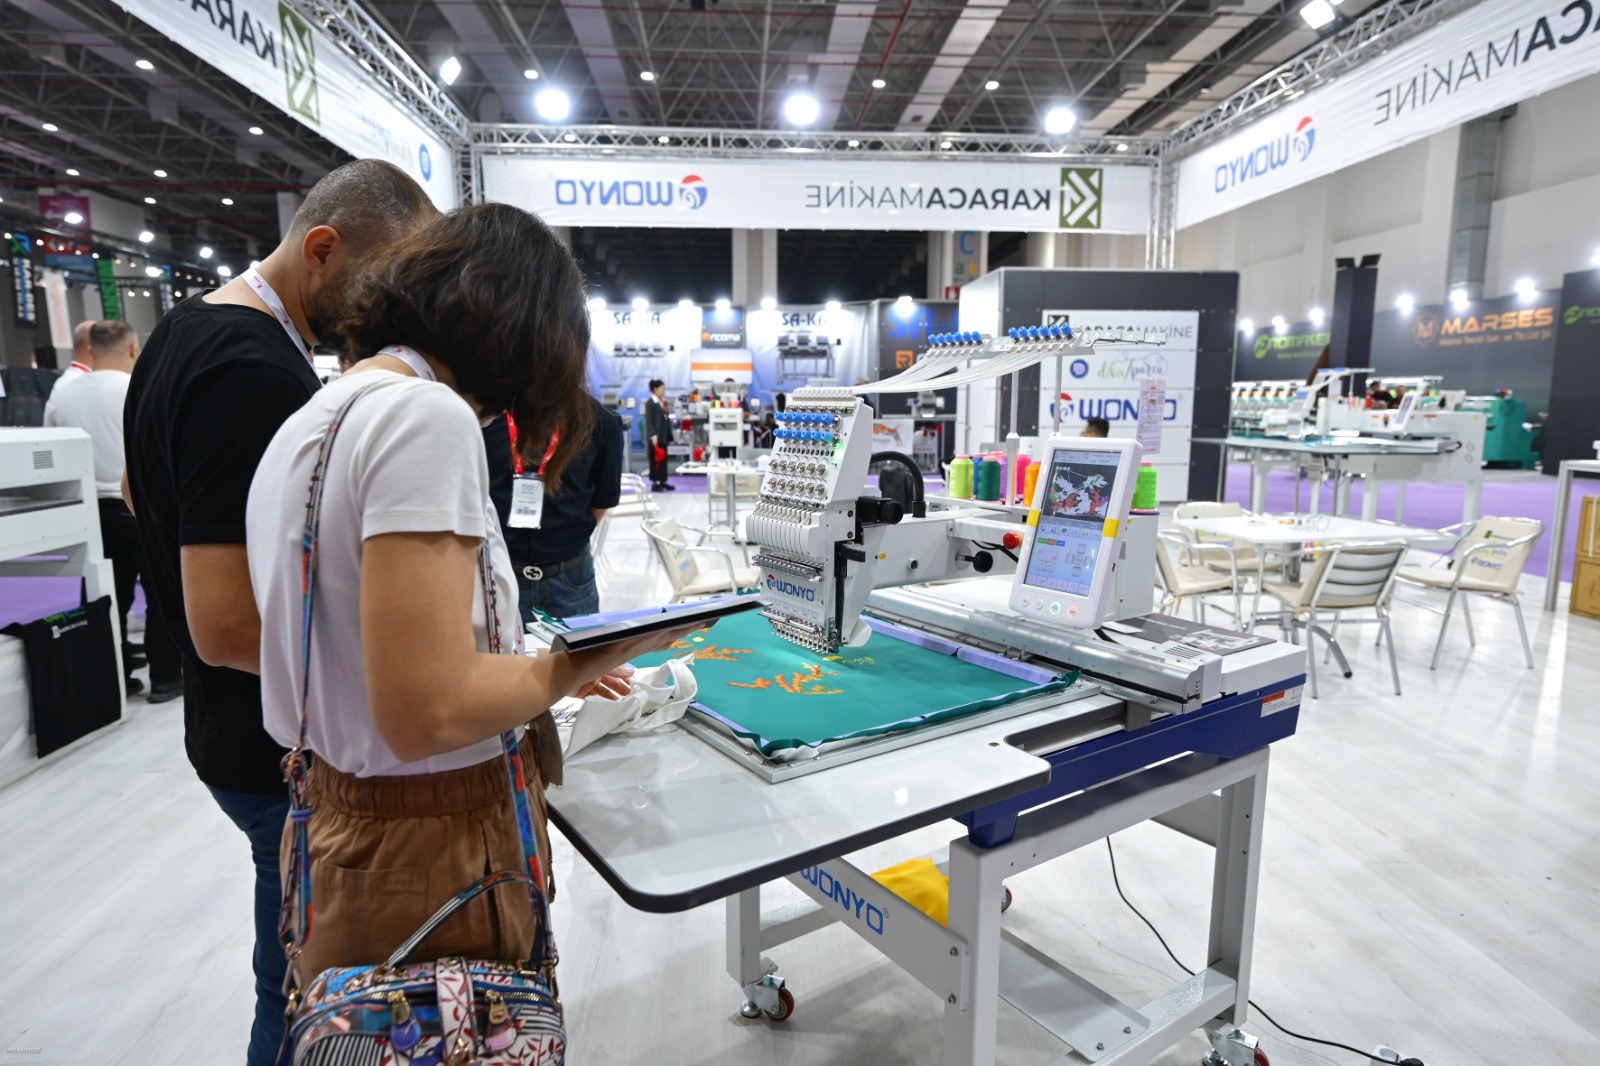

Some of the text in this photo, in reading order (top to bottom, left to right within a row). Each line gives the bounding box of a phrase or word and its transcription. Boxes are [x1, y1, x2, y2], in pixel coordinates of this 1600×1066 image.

[1440, 307, 1553, 335] MARSES
[1080, 398, 1177, 421] WONO
[776, 579, 815, 602] WONYO
